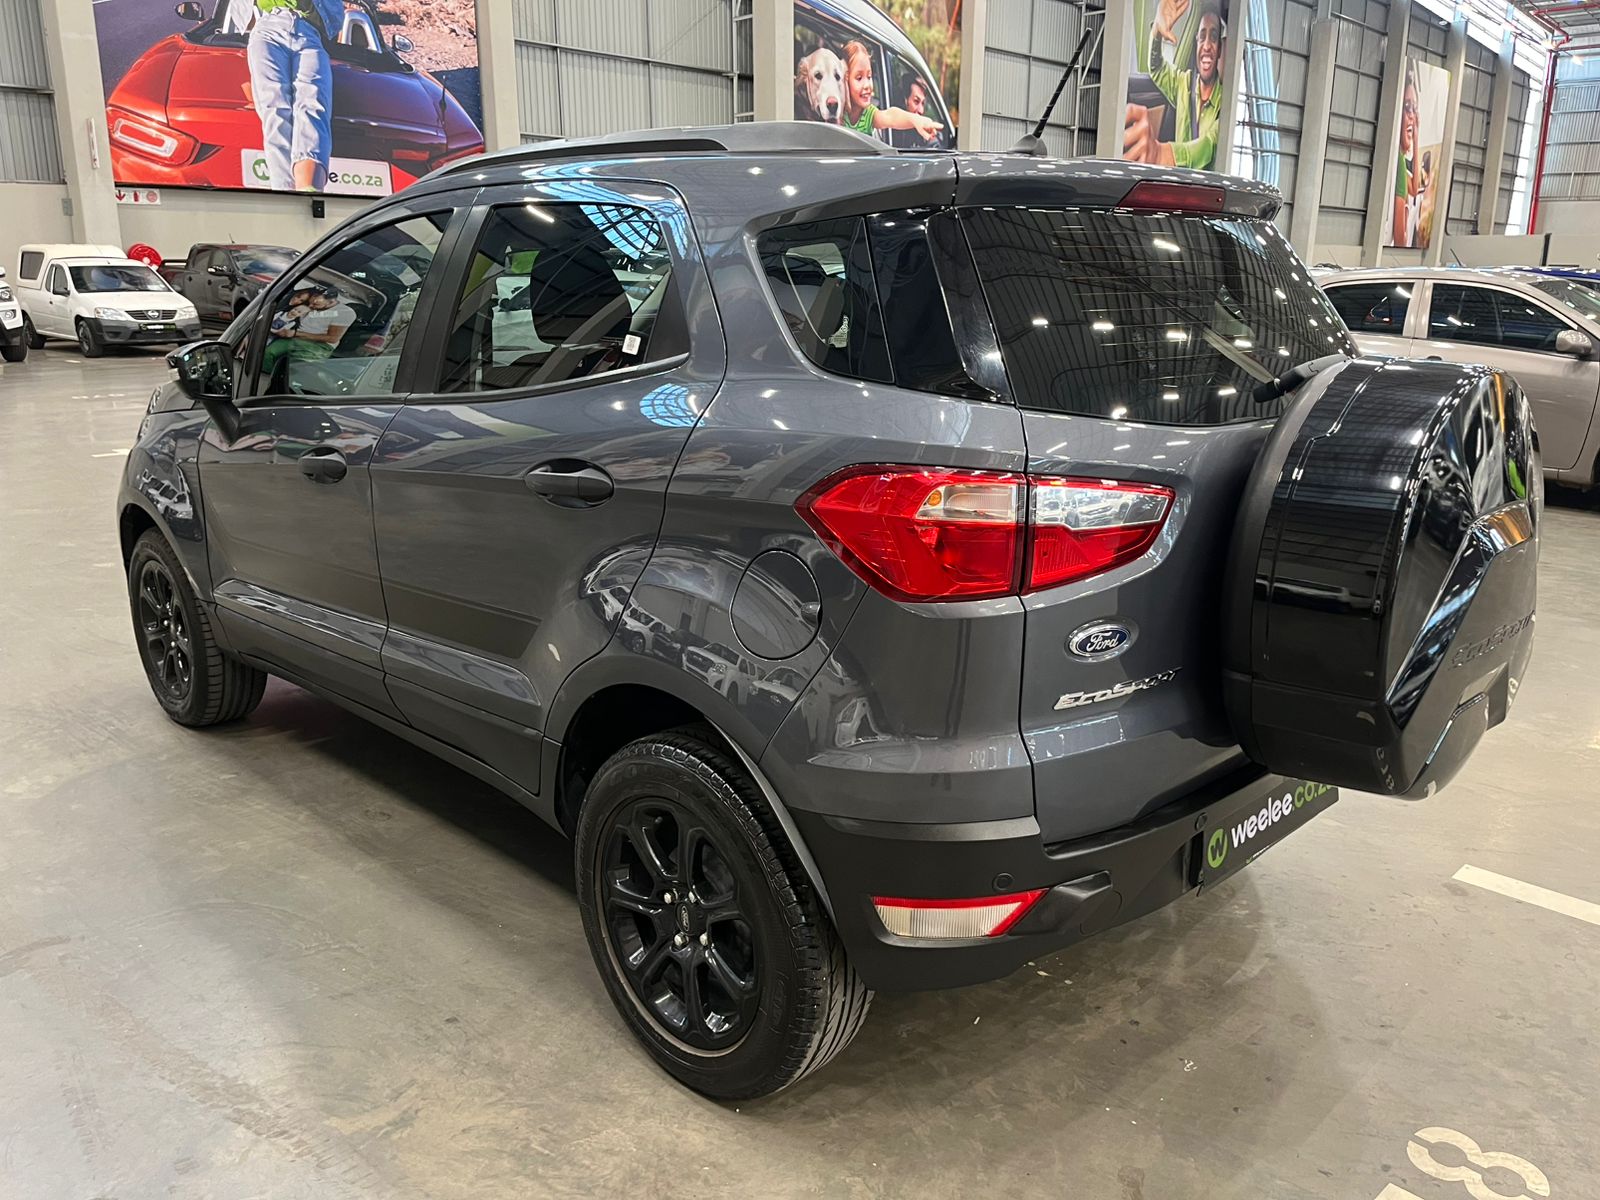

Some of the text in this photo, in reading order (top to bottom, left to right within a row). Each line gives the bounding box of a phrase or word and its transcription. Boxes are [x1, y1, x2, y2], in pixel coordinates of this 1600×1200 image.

[329, 171, 383, 187] e.co.za
[1086, 631, 1120, 652] Ford
[1231, 782, 1336, 848] weelee.co.z
